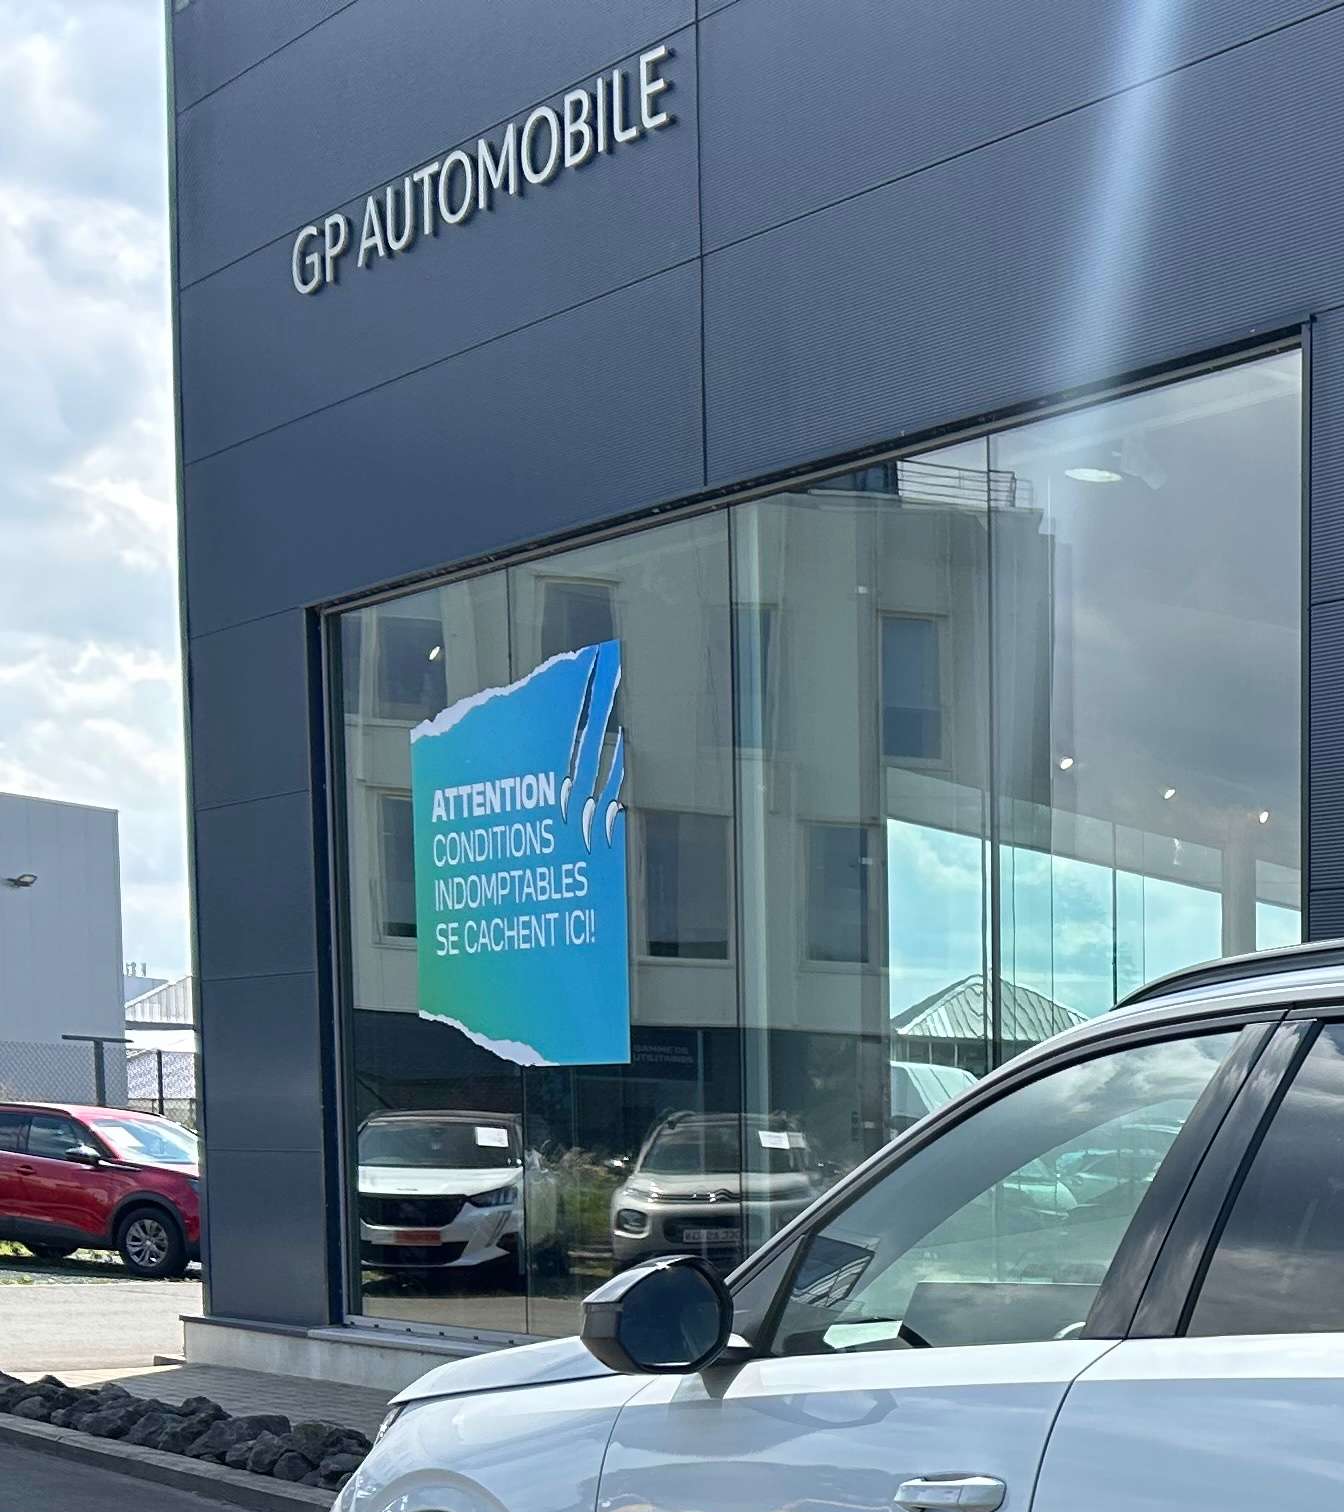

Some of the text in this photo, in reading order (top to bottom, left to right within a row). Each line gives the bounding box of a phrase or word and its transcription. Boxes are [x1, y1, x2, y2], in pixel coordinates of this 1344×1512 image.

[291, 45, 669, 295] GP AUTOMOBILE
[432, 772, 556, 823] ATTENTION
[433, 819, 555, 868] CONDITIONS
[434, 861, 588, 913] INDOMPTABLES
[436, 908, 596, 957] SE CACHENT ICI!
